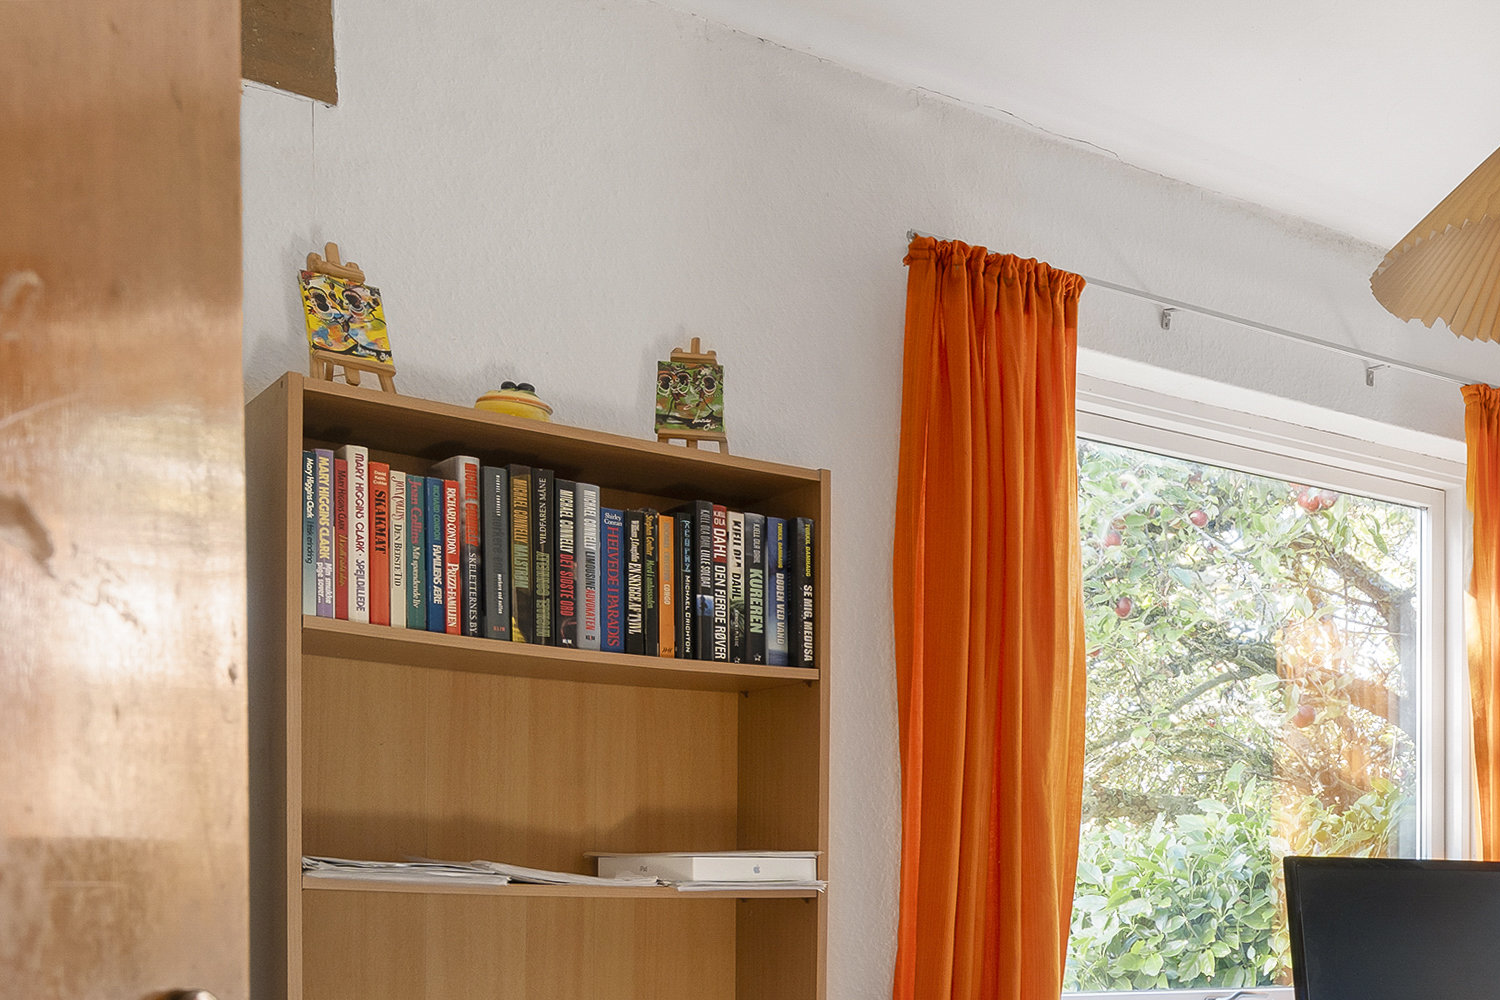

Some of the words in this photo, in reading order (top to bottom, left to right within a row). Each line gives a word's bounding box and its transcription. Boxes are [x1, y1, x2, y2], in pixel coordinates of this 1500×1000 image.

[304, 458, 314, 475] Mary
[318, 457, 329, 486] MARY
[304, 476, 314, 500] Higgins
[560, 489, 573, 517] MICHAEL
[318, 487, 330, 525] HIGGINS
[447, 487, 456, 523] RICHARD
[375, 490, 386, 554] SKAKMAT
[394, 524, 402, 542] DEN
[560, 520, 573, 553] CONNELLY
[319, 527, 330, 559] CLARK
[447, 523, 456, 555] CONDON
[713, 528, 726, 559] DAHL
[394, 543, 402, 572] BEDSTE
[560, 554, 573, 568] DET
[607, 526, 619, 585] HELVEDE
[394, 573, 402, 587] TID
[468, 552, 478, 621] SKELETTERNES
[560, 571, 573, 599] SIDSTE
[714, 565, 726, 586] DEN
[732, 573, 741, 600] DAHL
[776, 573, 784, 602] DØDEN
[447, 563, 459, 627] PRIZZI-FAMILIEN
[714, 589, 726, 623] FJERDE
[750, 568, 763, 633] KUREREN
[804, 585, 812, 597] SE
[560, 600, 574, 616] ORD
[607, 593, 619, 646] PARADIS
[470, 622, 477, 634] BY
[715, 626, 726, 659] RØVER
[804, 621, 812, 661] MEDUSA
